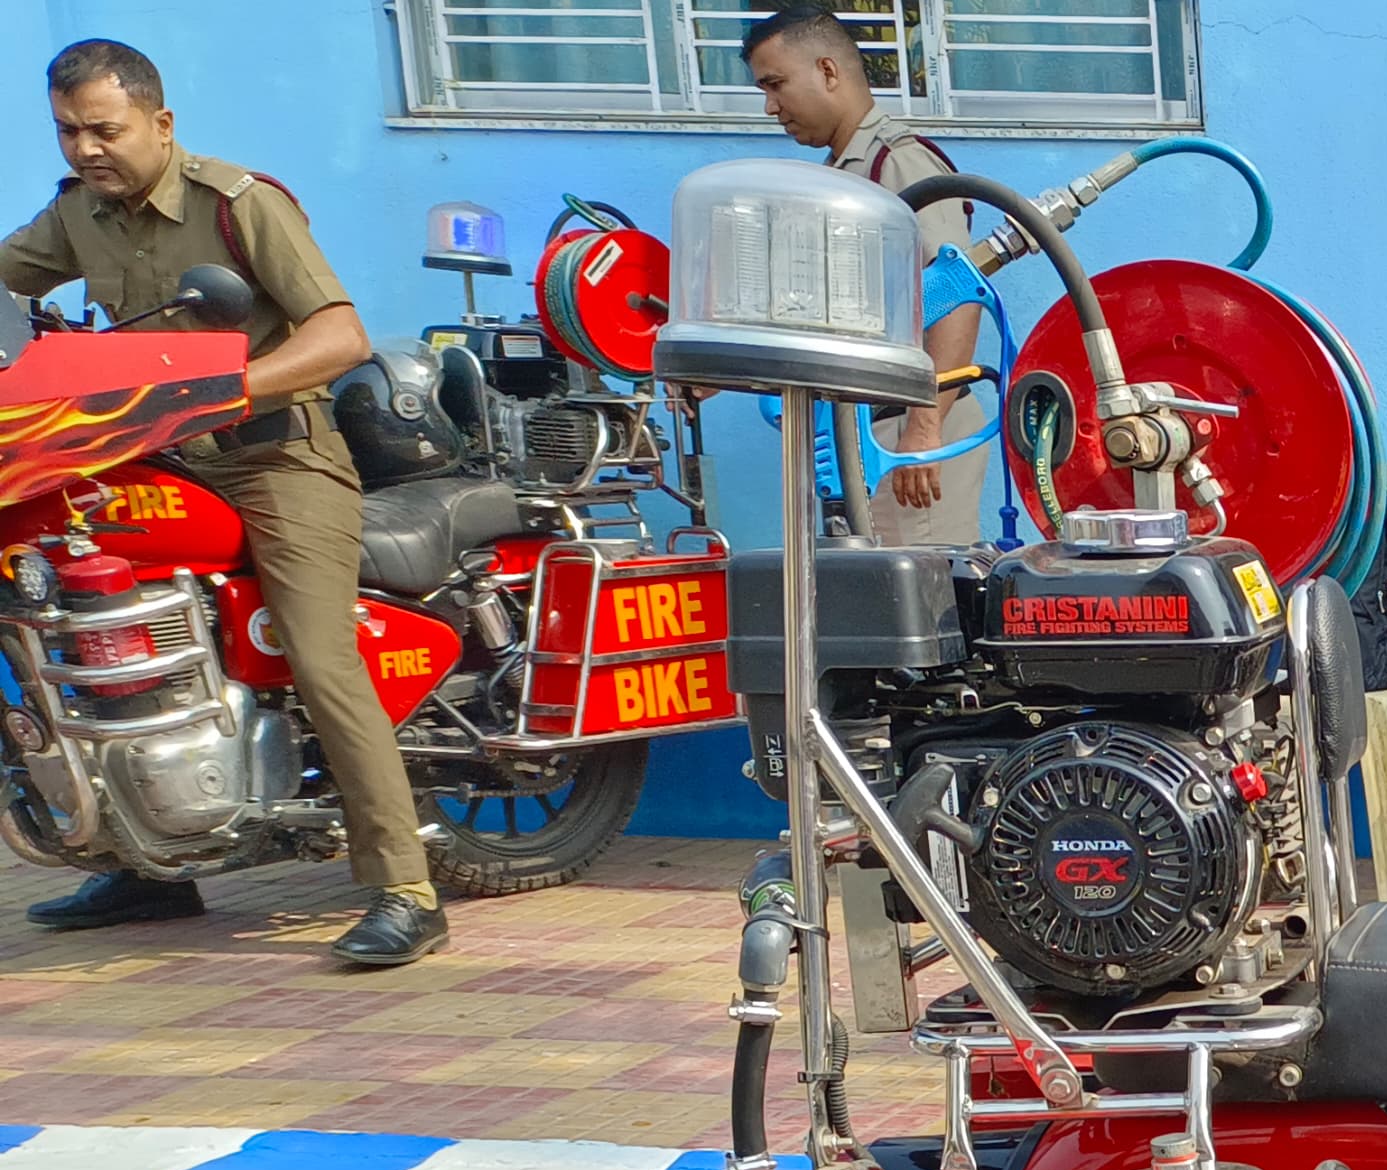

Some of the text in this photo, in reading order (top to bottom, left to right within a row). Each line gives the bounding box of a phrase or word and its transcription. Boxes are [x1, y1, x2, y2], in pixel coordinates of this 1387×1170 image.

[105, 484, 188, 521] FIRE
[614, 582, 706, 643] FIRE
[1002, 595, 1189, 621] CRISTANINI
[1003, 620, 1189, 635] FIRE FIGHTING SYSTEMS
[380, 648, 431, 680] FIRE
[614, 659, 712, 723] BIKE
[1051, 839, 1133, 852] HONDA
[1055, 856, 1129, 884] GX
[1073, 885, 1117, 900] 120
